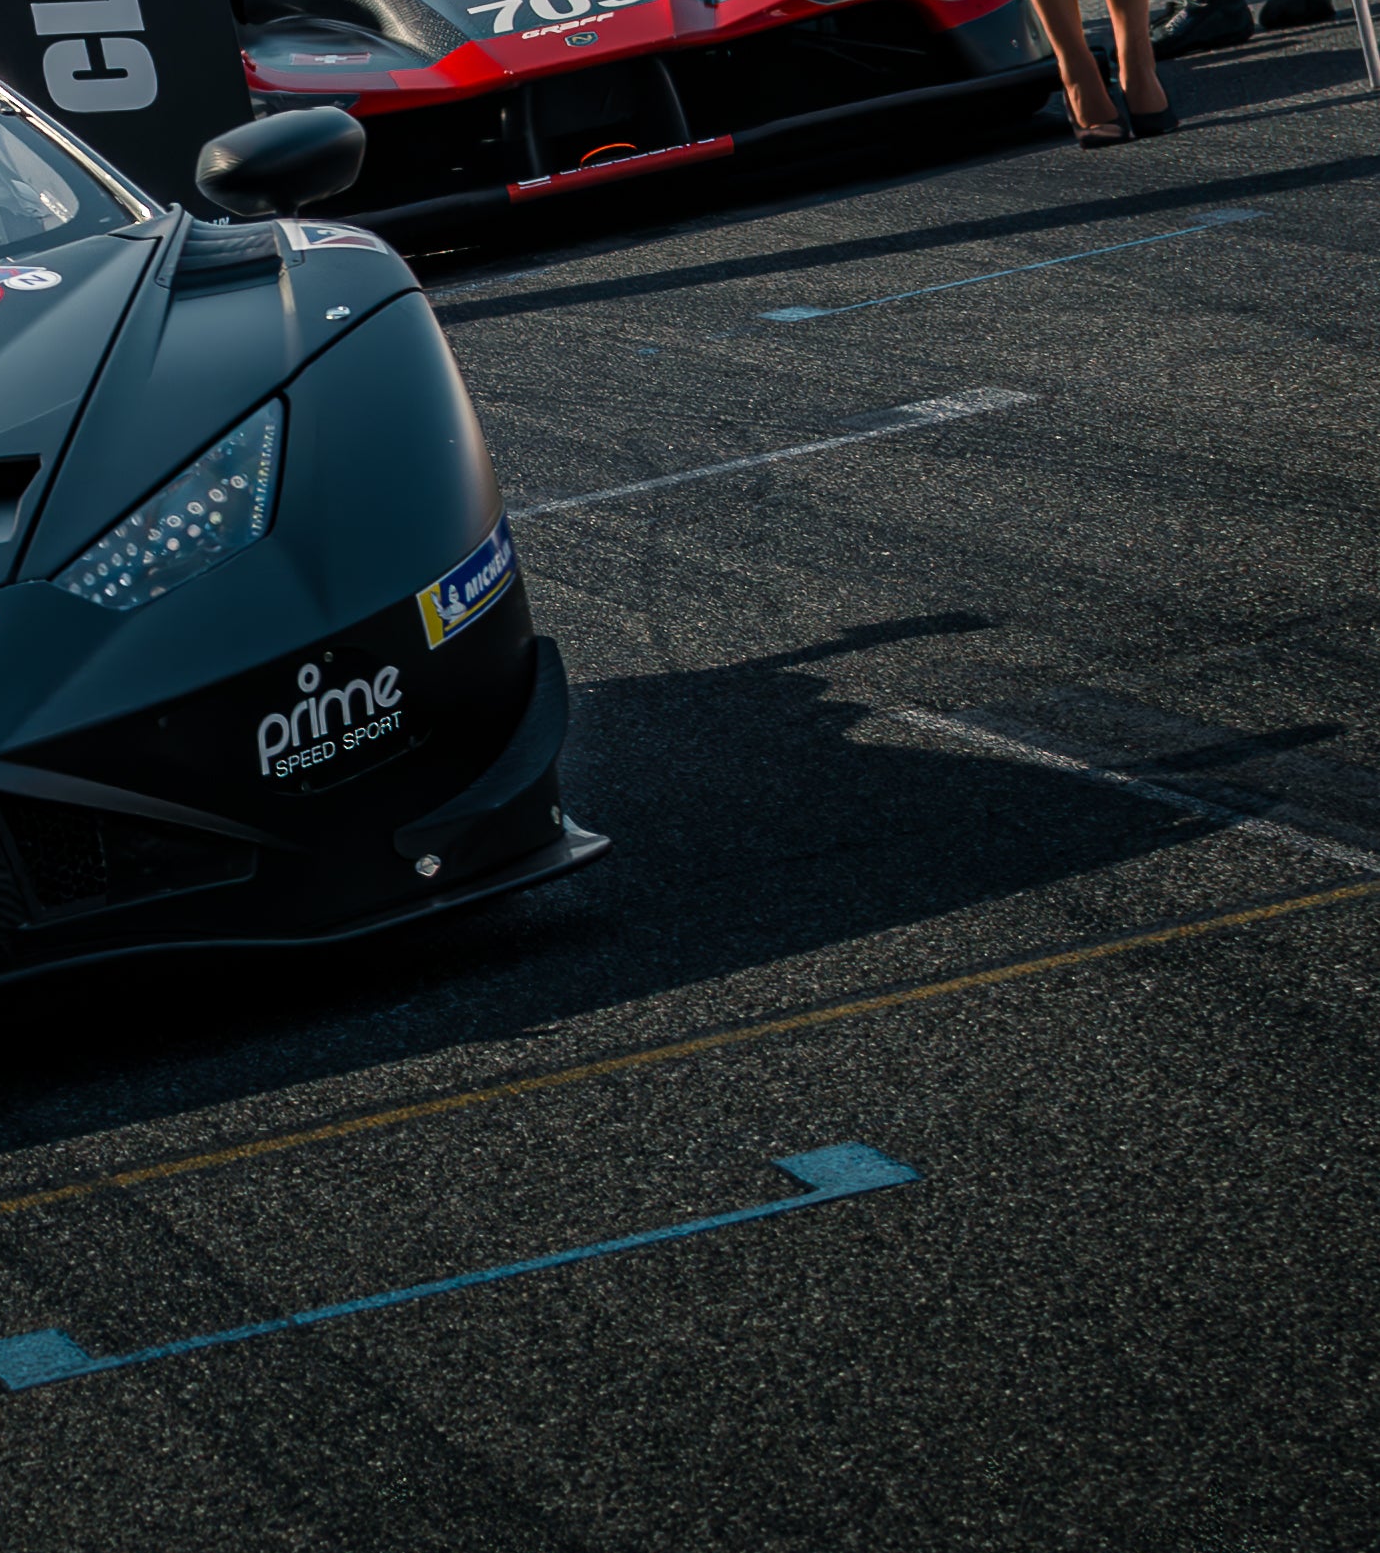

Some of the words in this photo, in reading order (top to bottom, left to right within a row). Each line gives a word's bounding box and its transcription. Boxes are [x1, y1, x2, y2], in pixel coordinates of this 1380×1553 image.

[257, 662, 402, 776] prime
[274, 741, 336, 779] SPEED
[342, 710, 403, 752] SPORT
